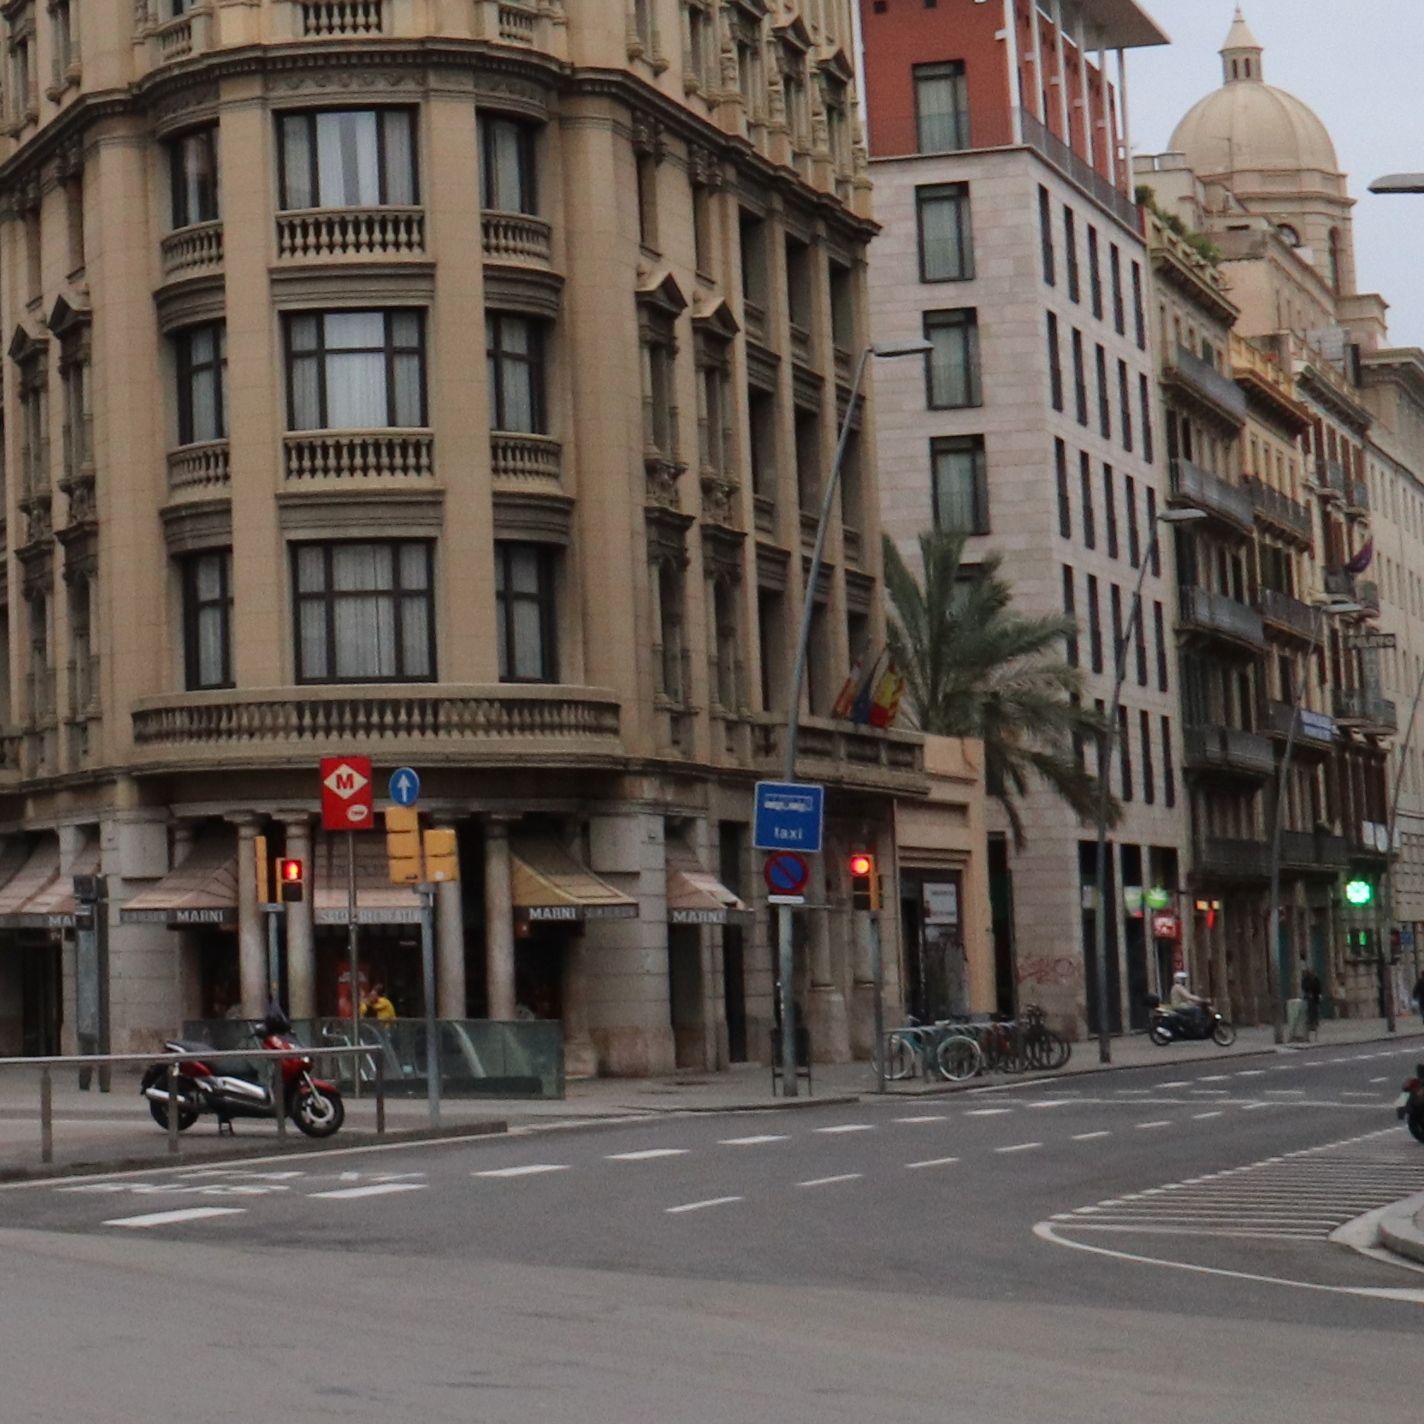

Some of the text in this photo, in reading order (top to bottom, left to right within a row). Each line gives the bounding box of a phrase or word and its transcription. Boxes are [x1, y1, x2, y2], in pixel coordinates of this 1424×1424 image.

[336, 773, 354, 790] M
[774, 826, 803, 840] taxi
[48, 915, 76, 926] MA
[176, 909, 224, 923] MARNI
[528, 907, 577, 921] MARNI
[672, 908, 727, 924] MARNI
